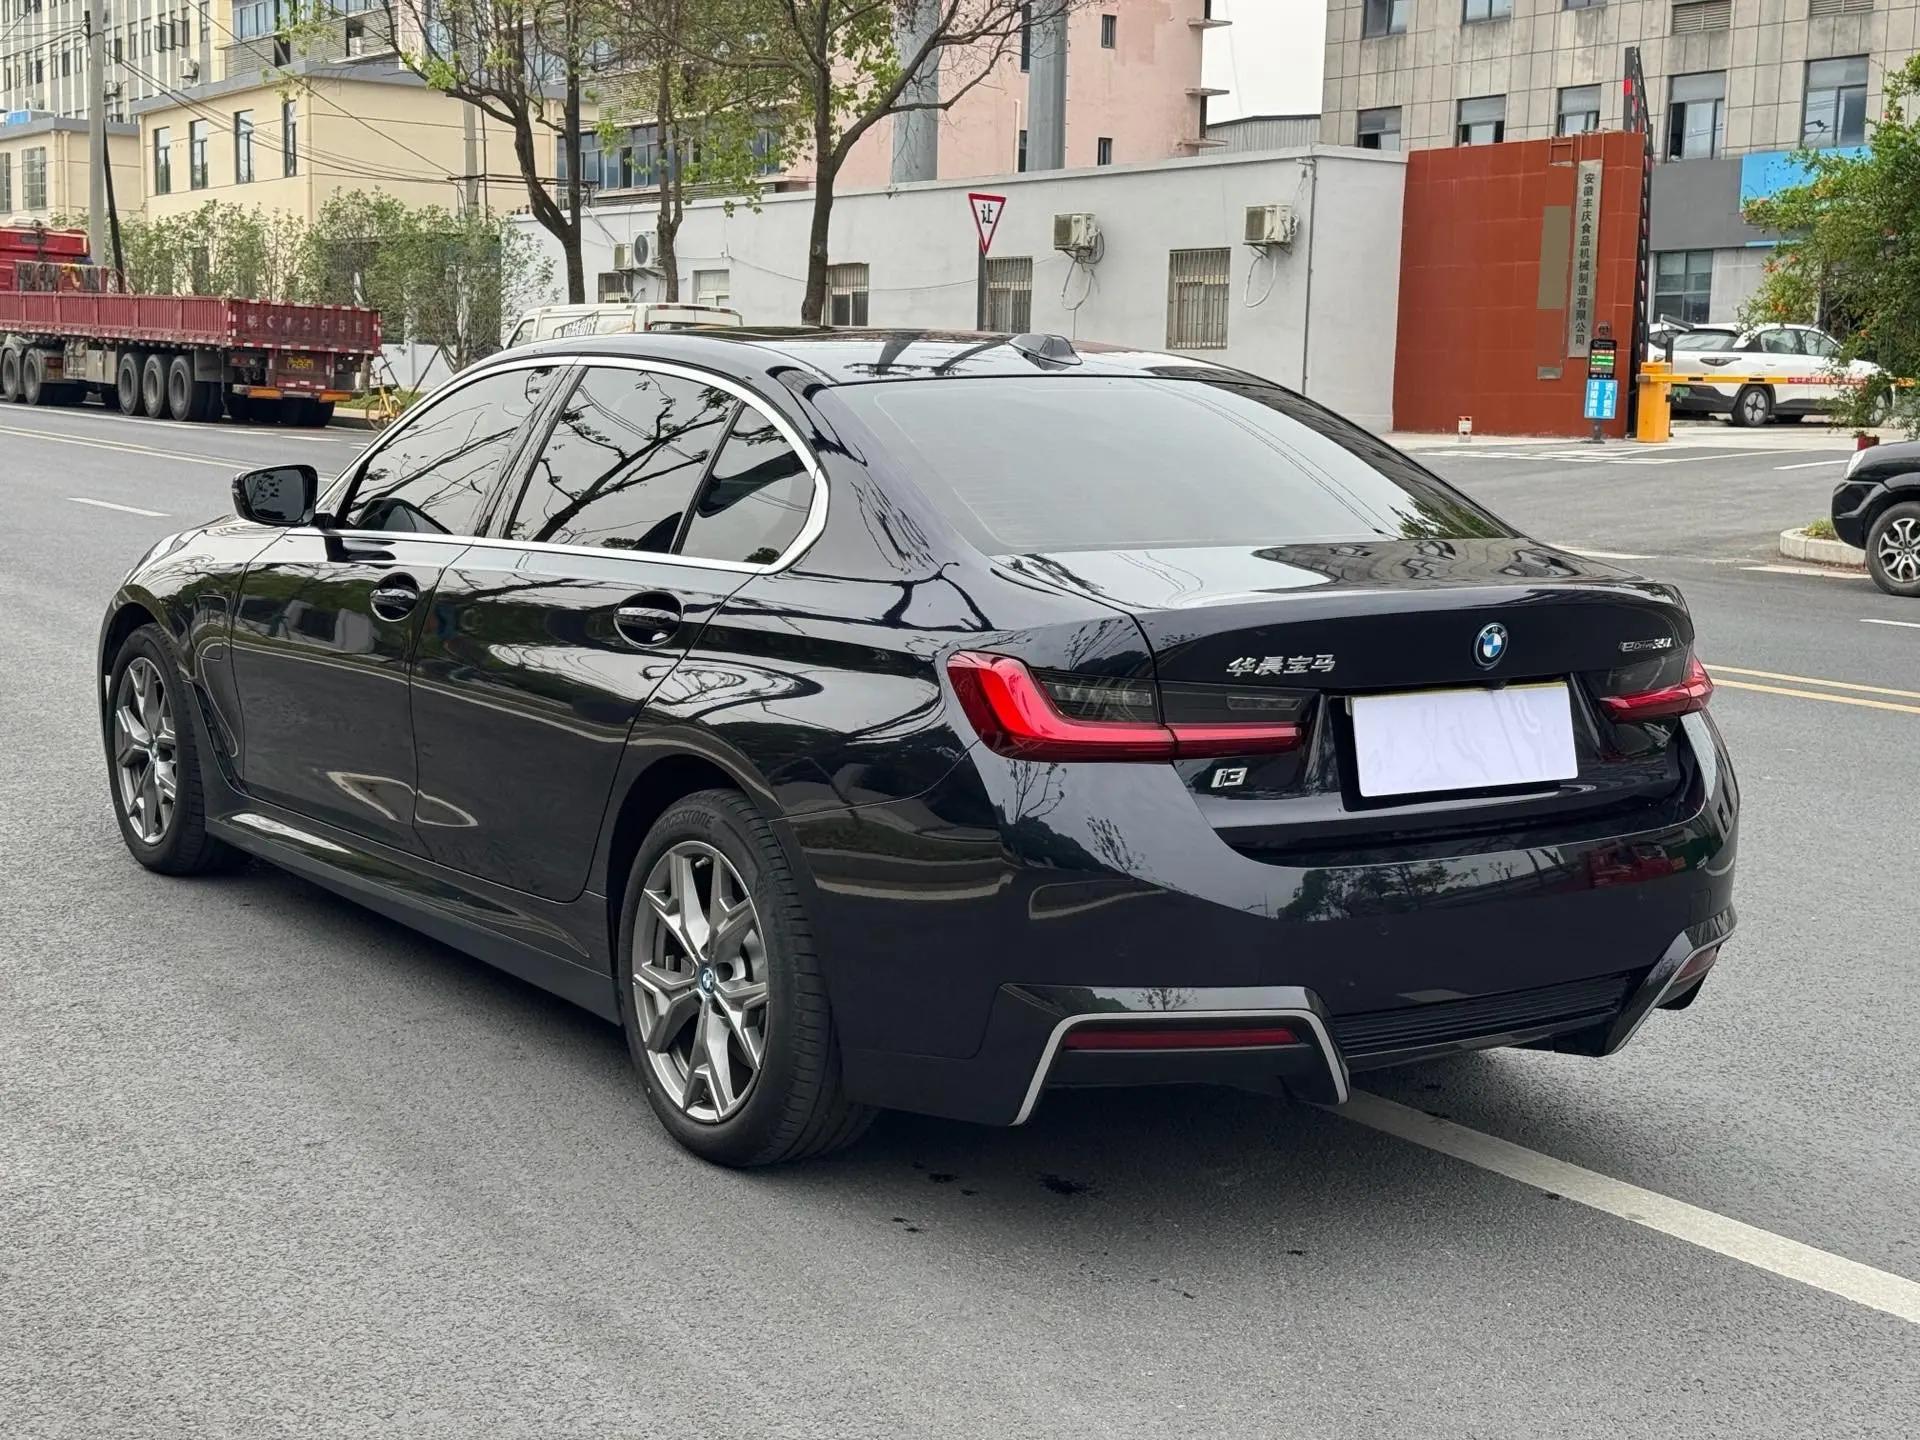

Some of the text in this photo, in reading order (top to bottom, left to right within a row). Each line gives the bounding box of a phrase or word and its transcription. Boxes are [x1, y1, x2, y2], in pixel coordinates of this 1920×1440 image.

[981, 203, 993, 224] 让
[1575, 172, 1595, 346] 安徽丰庆食品机械制造有限公司
[1226, 654, 1336, 677] 华晨宝马
[1211, 767, 1248, 788] i3
